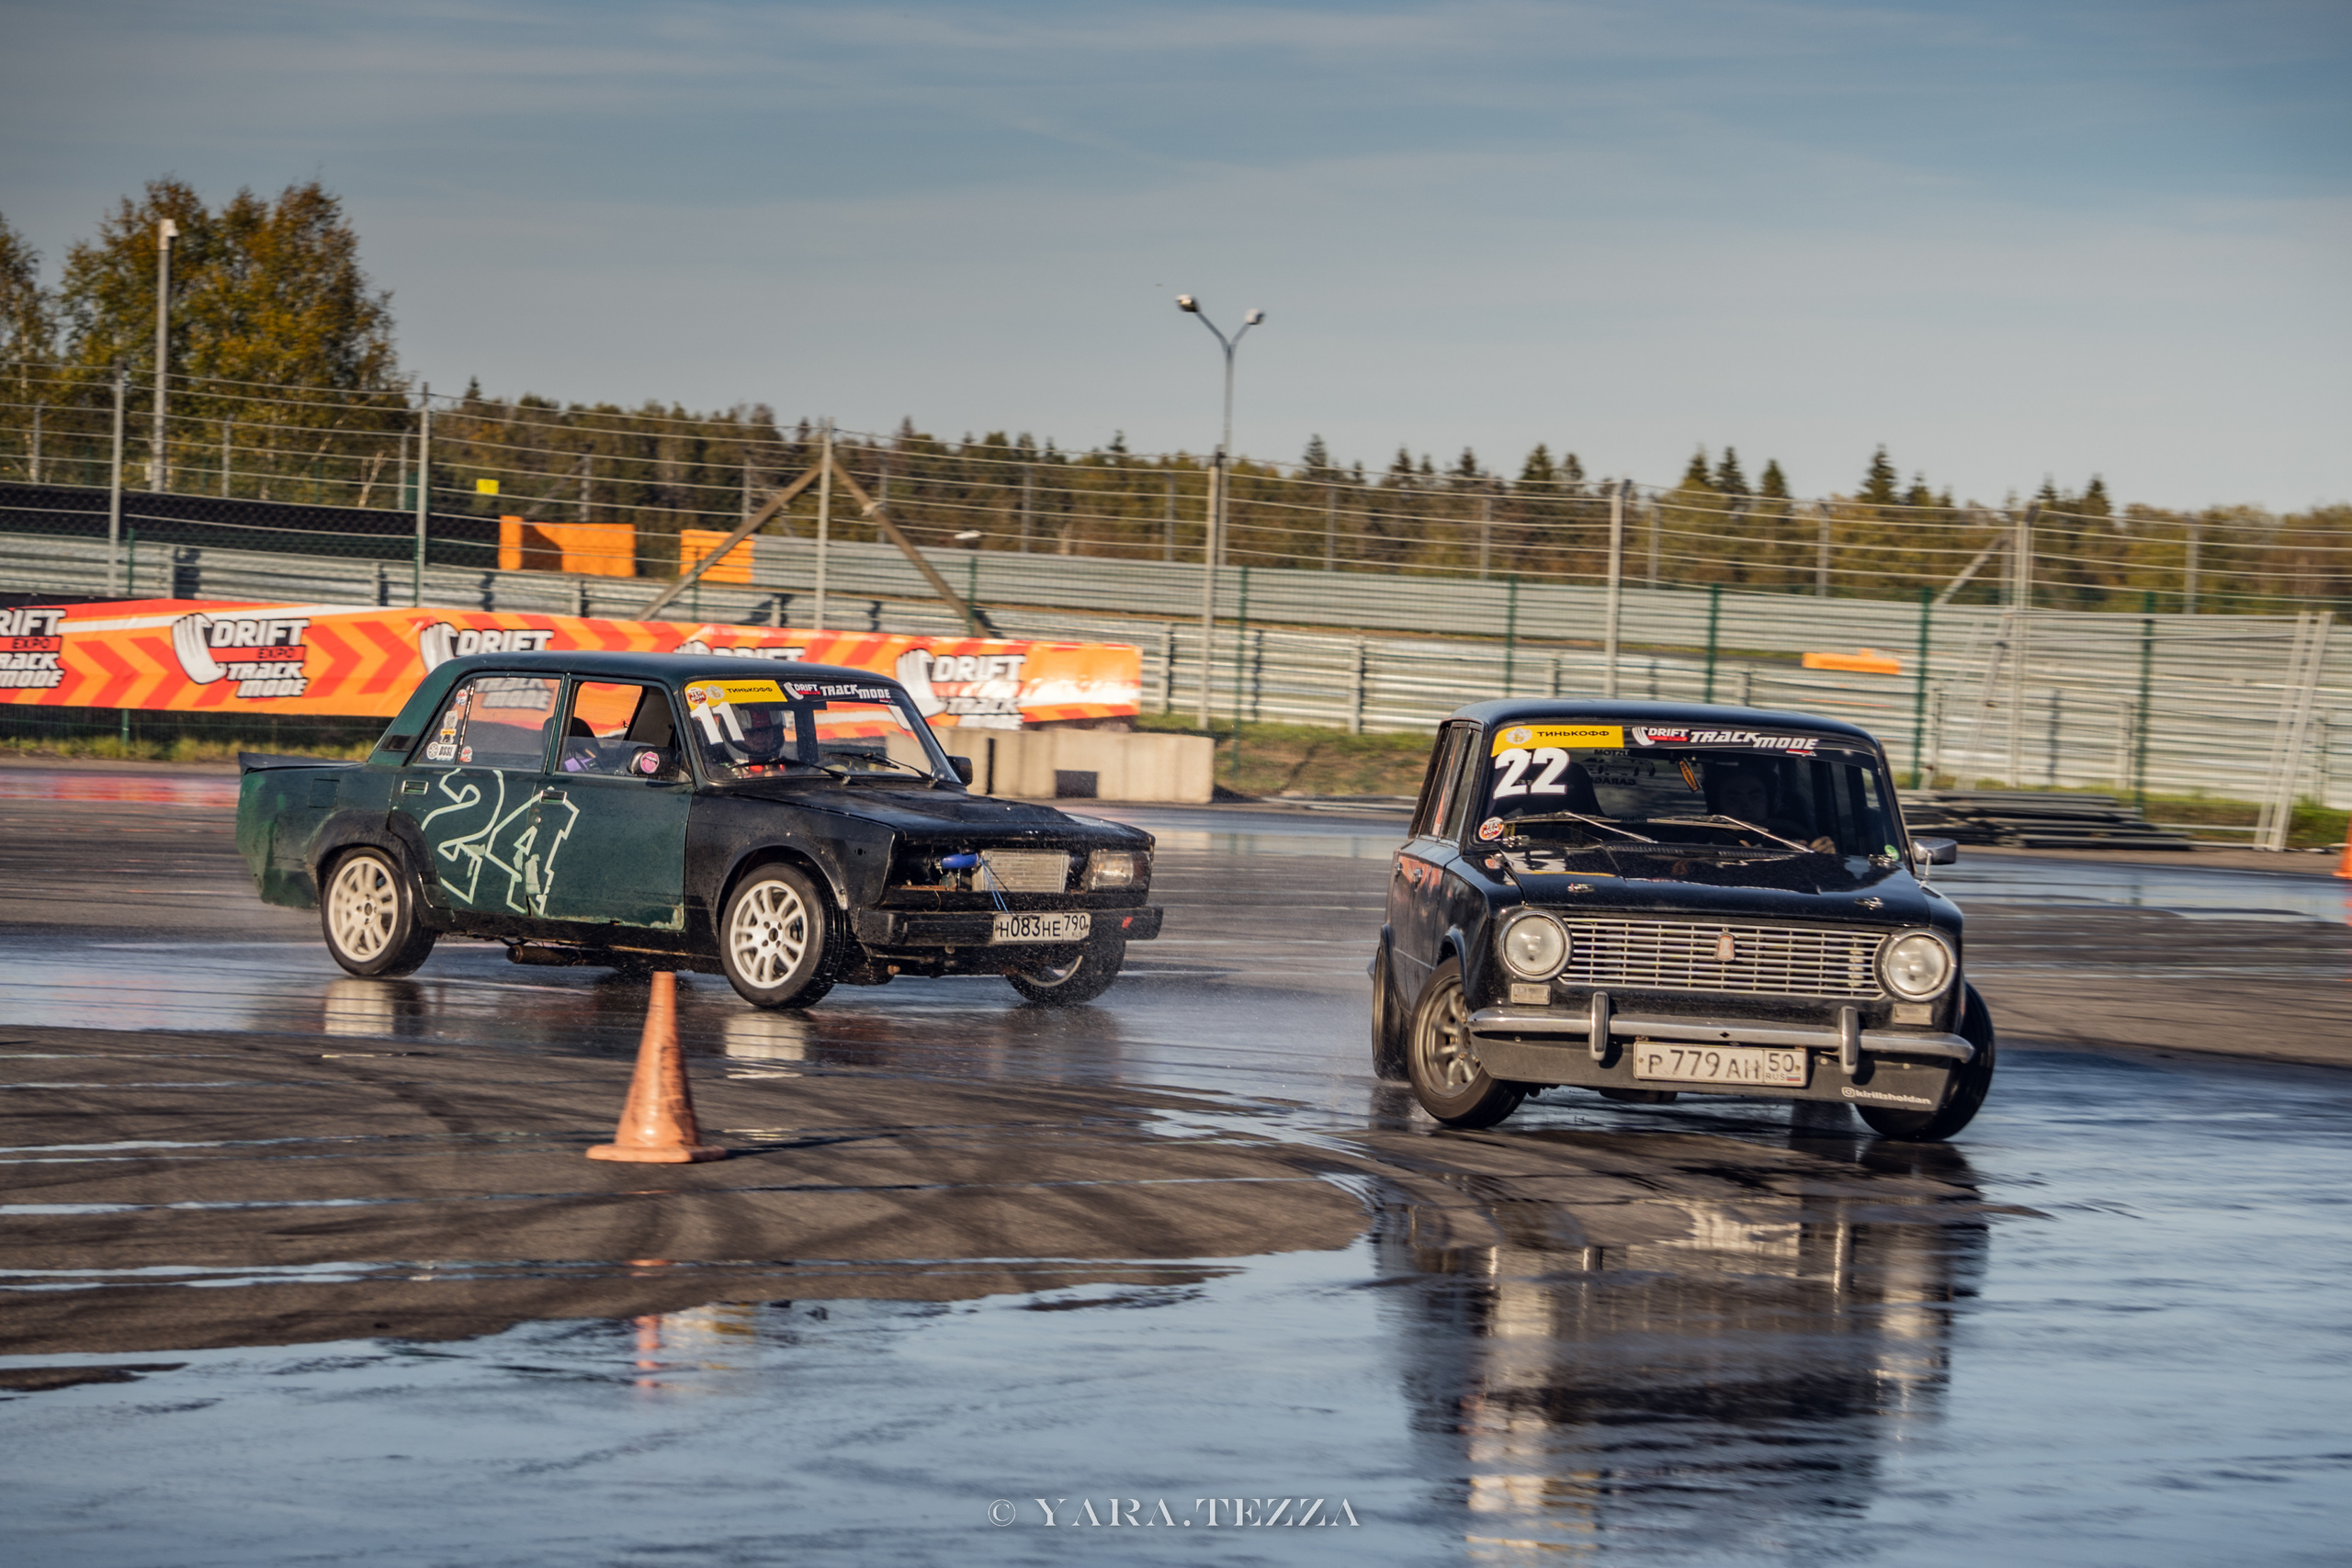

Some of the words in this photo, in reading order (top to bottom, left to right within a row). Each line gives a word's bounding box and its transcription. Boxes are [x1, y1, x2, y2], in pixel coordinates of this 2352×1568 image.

[0, 609, 66, 636] RIFT
[210, 619, 311, 647] DRIFT
[456, 629, 554, 656] DRIFT
[0, 653, 60, 670] RACK
[226, 662, 304, 680] TRACK
[933, 655, 1026, 681] DRIFT
[235, 679, 309, 697] MODE
[794, 683, 818, 692] DRIFT
[820, 684, 859, 696] TRACK
[857, 689, 891, 699] MODE
[690, 701, 746, 745] 11
[1537, 729, 1610, 738] ТИНЬКОФФ
[1647, 728, 1690, 738] DRIFT
[1690, 731, 1760, 743] TRACK
[1752, 737, 1819, 750] MODE
[1492, 747, 1570, 800] 22
[1064, 915, 1087, 931] 790
[1768, 1053, 1794, 1072] 50
[1765, 1072, 1785, 1081] RUS
